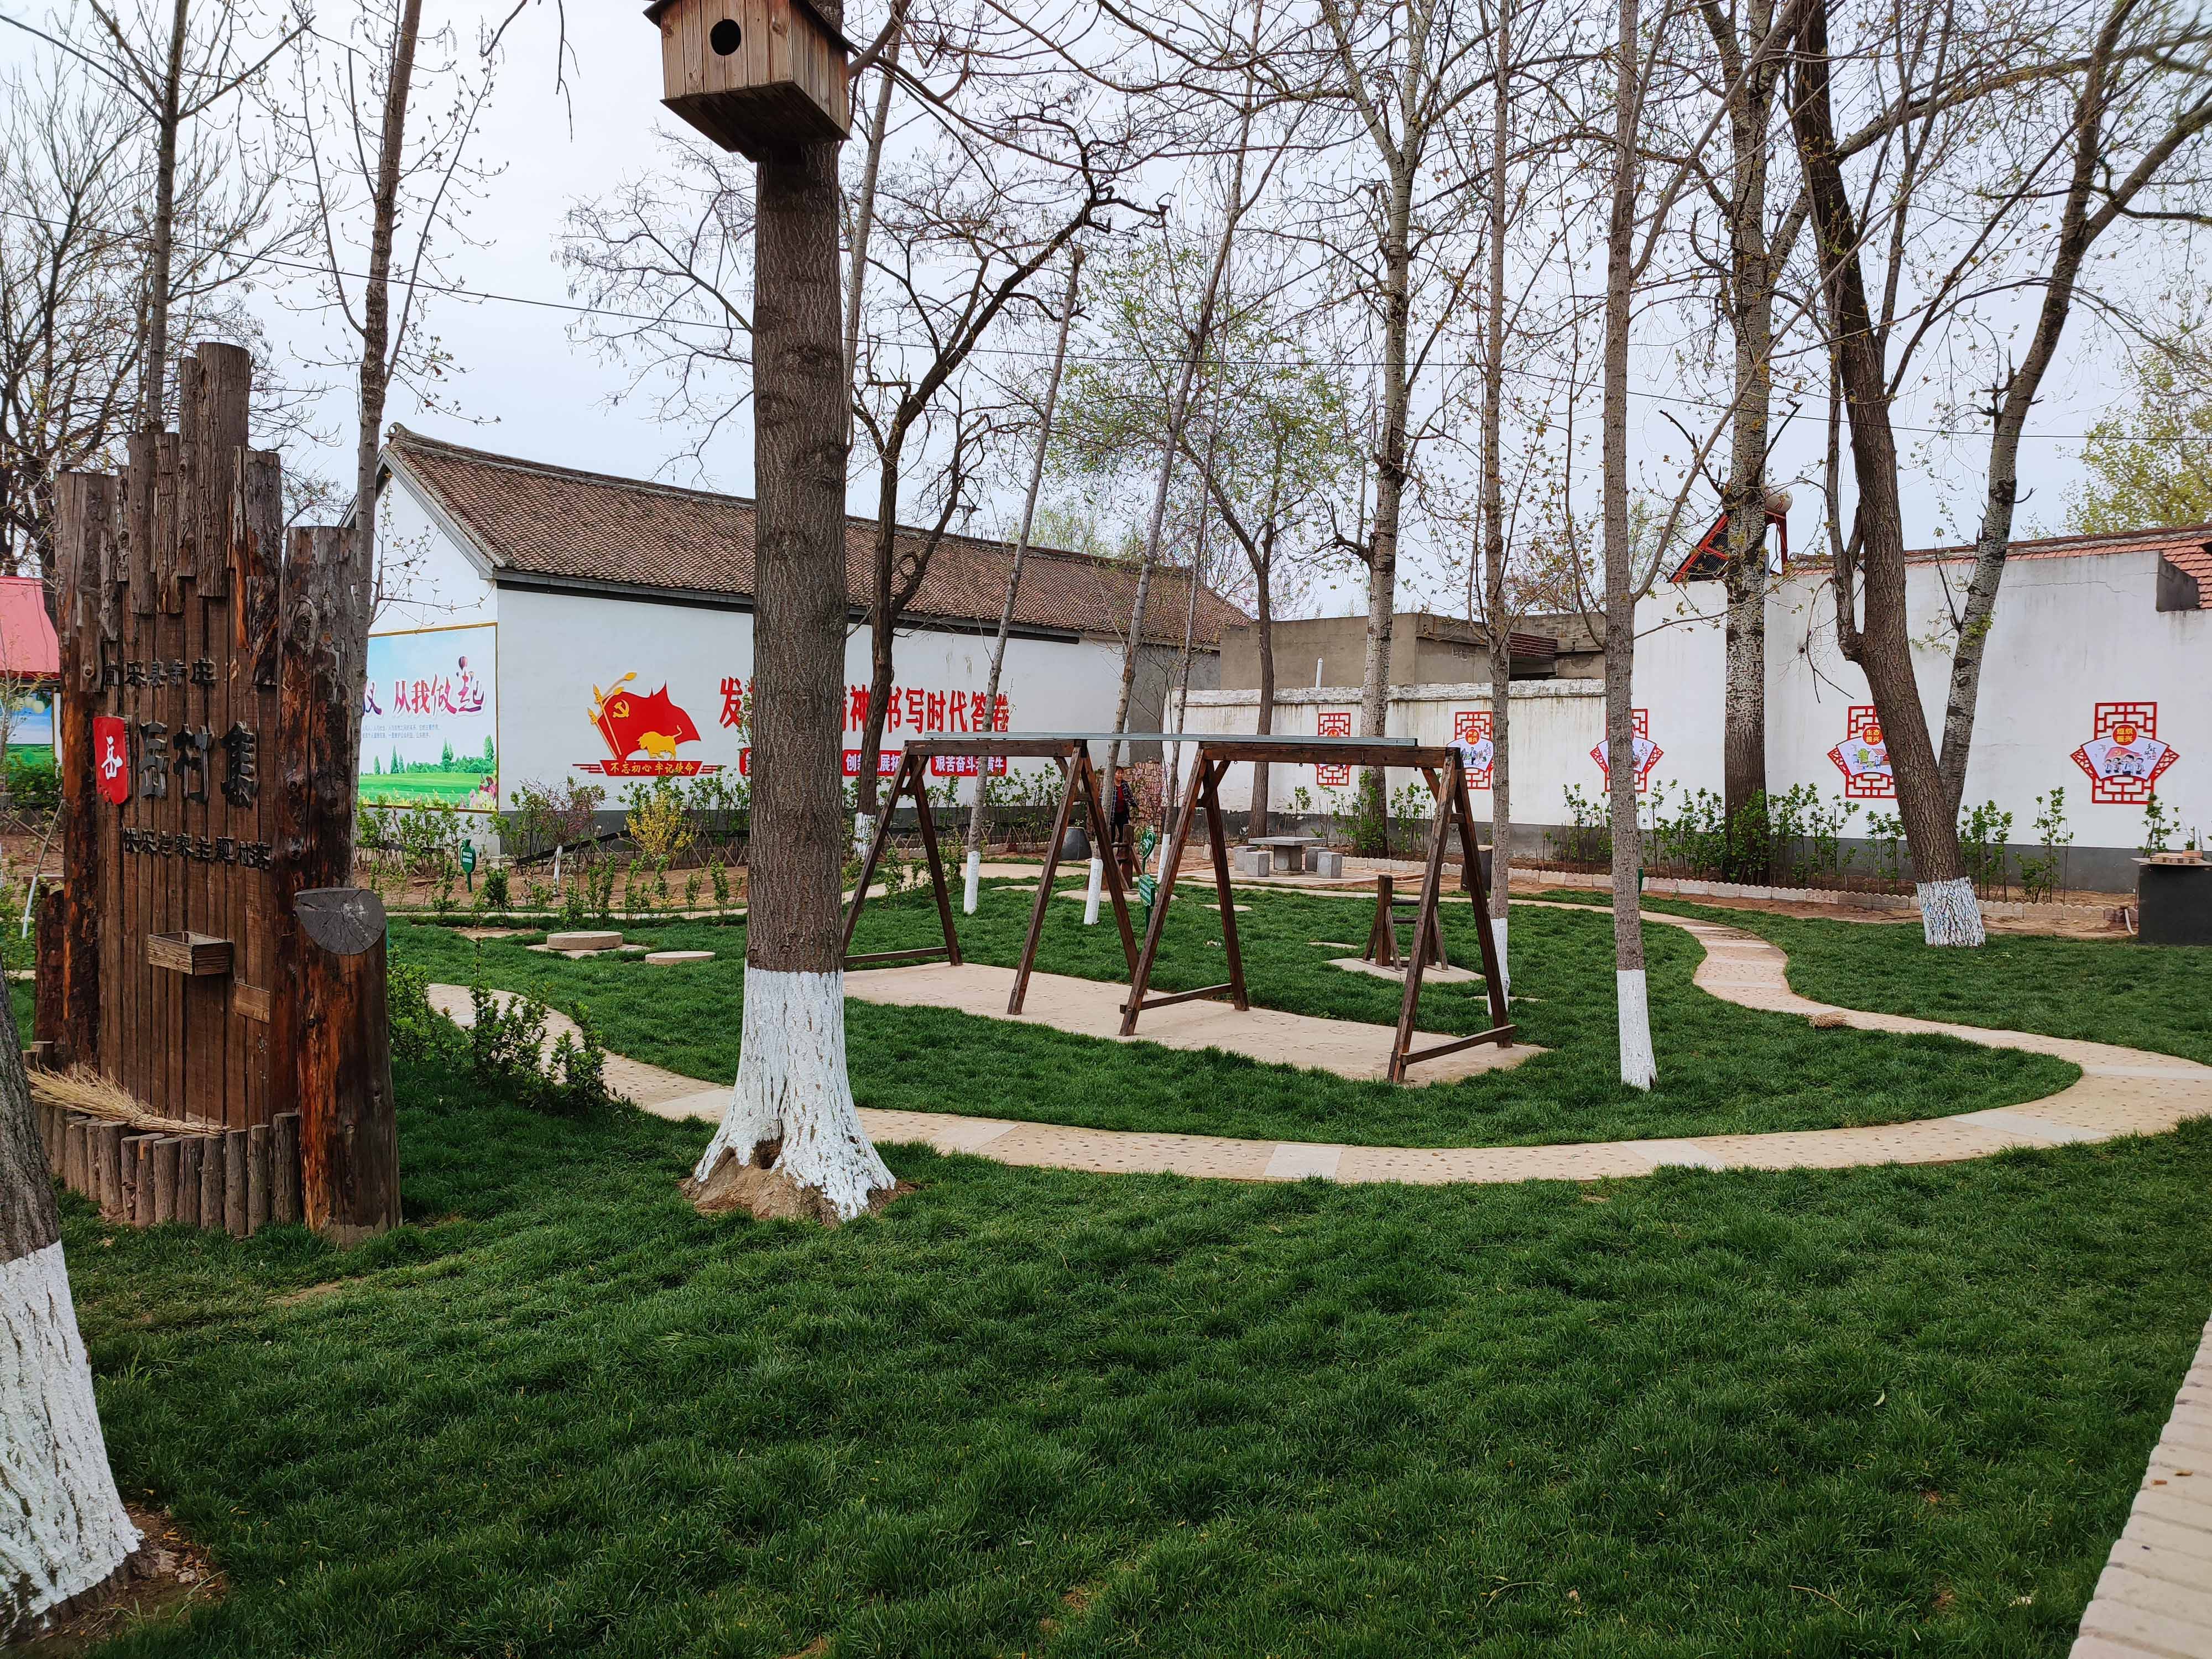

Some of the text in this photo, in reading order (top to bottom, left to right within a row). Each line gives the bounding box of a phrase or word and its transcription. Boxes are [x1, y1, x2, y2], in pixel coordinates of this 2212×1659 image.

[393, 671, 485, 716] 从我做起
[610, 761, 695, 775] 不忘初心 牢记使命
